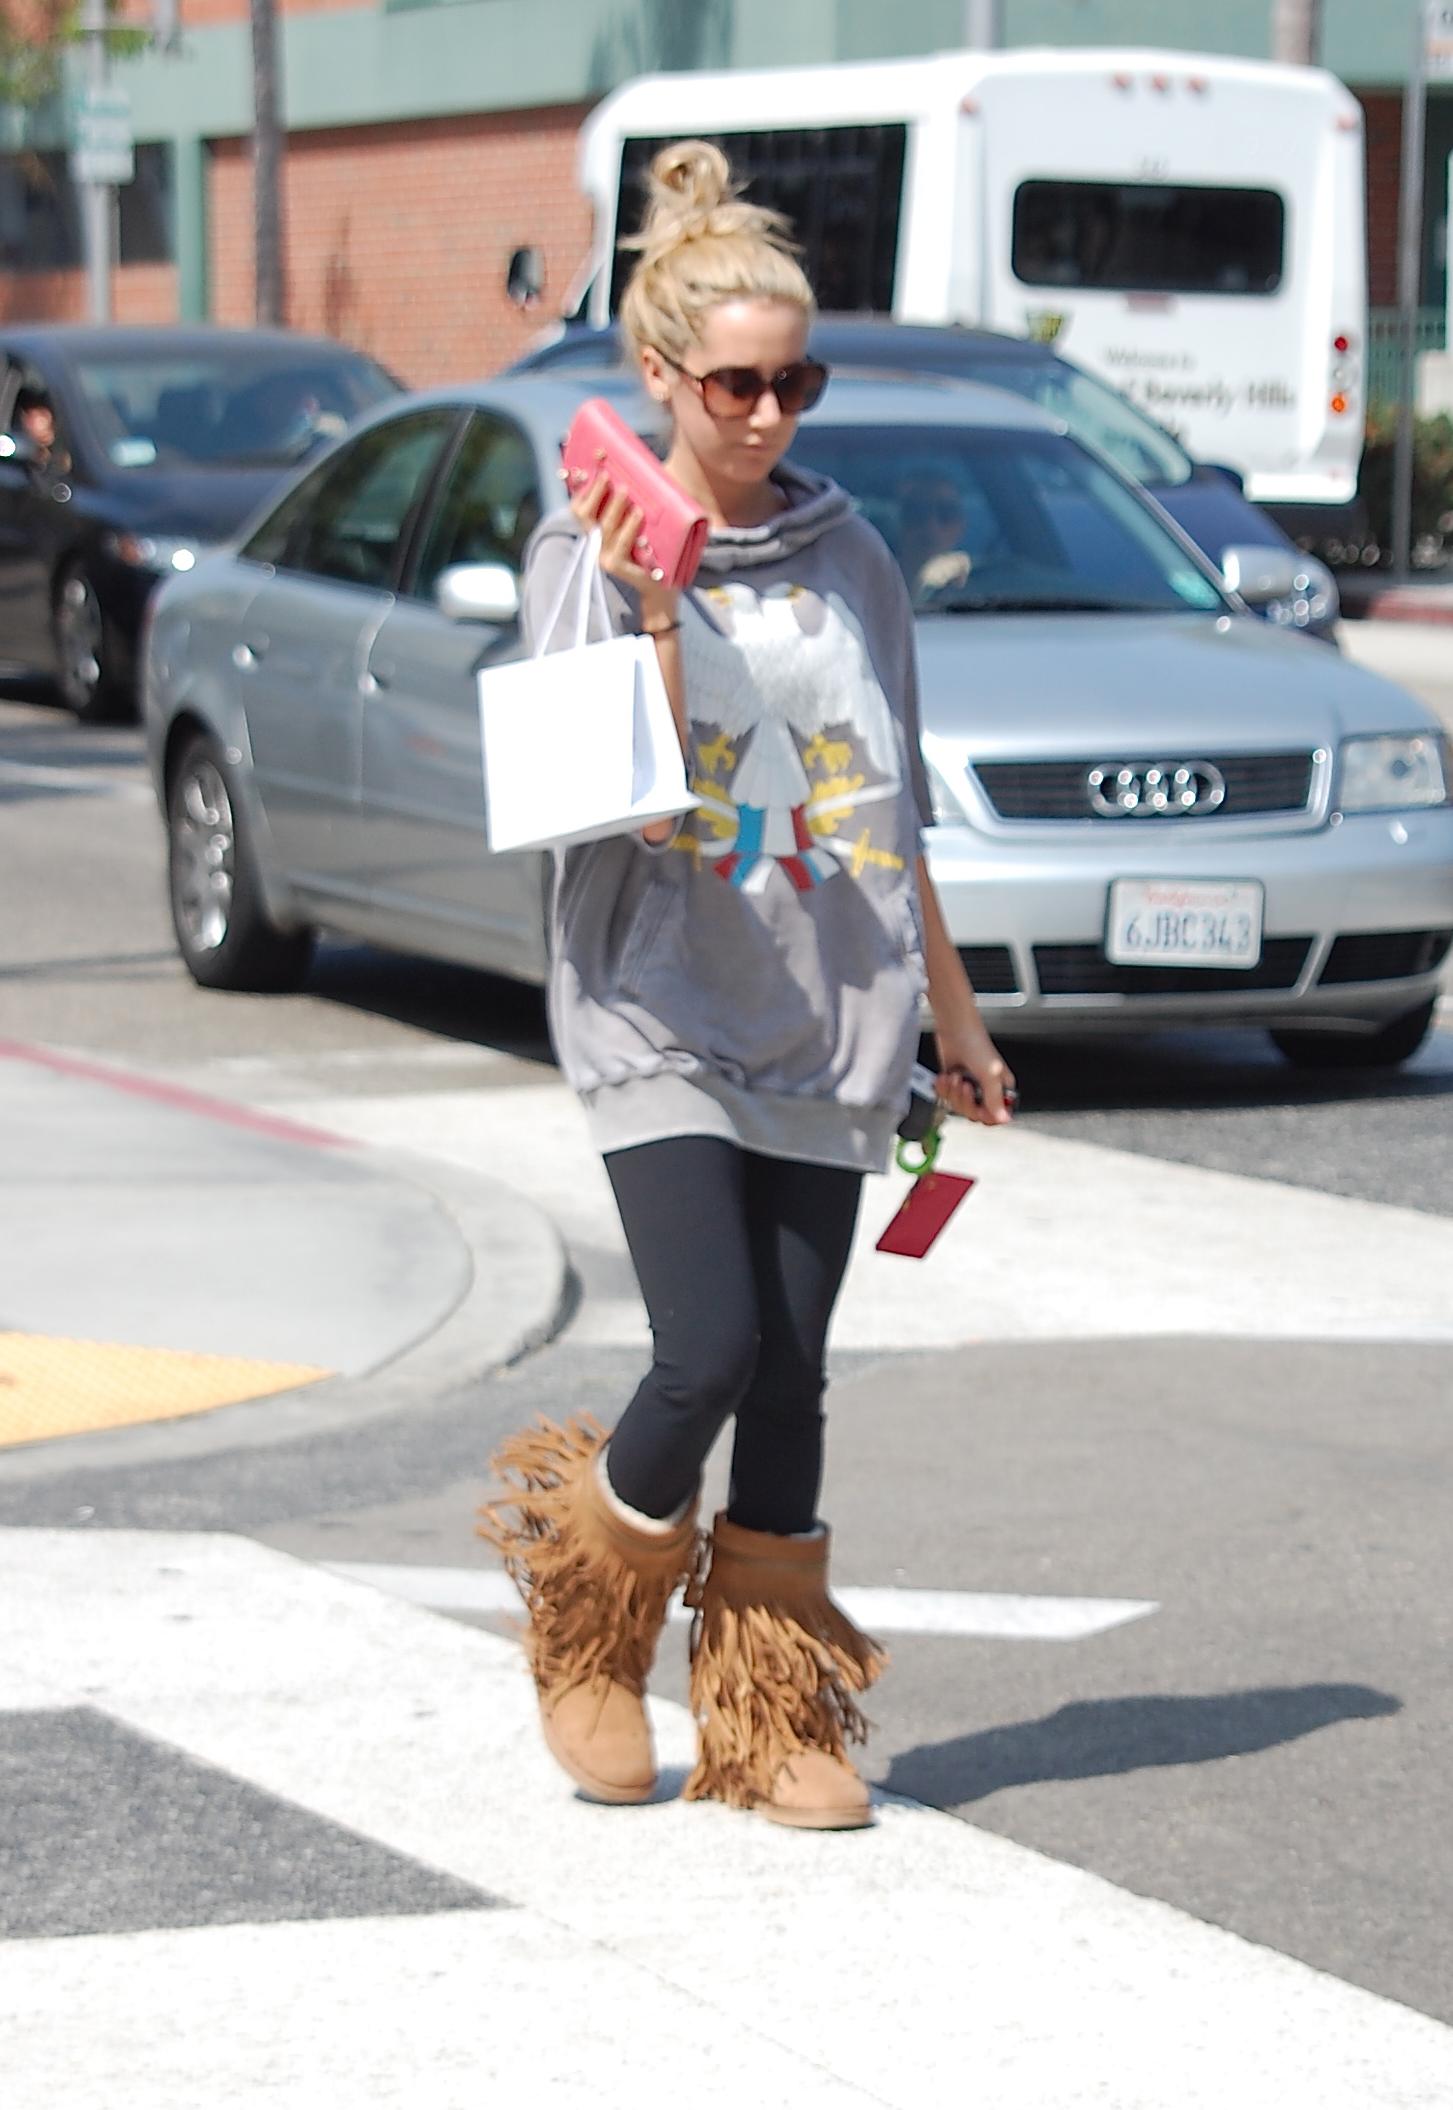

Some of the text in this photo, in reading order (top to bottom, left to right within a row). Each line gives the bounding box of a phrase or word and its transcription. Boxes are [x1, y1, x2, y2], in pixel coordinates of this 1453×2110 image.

[1146, 379, 1234, 416] Beverly
[1247, 379, 1296, 409] Hills
[1124, 910, 1250, 949] 6JBC343
